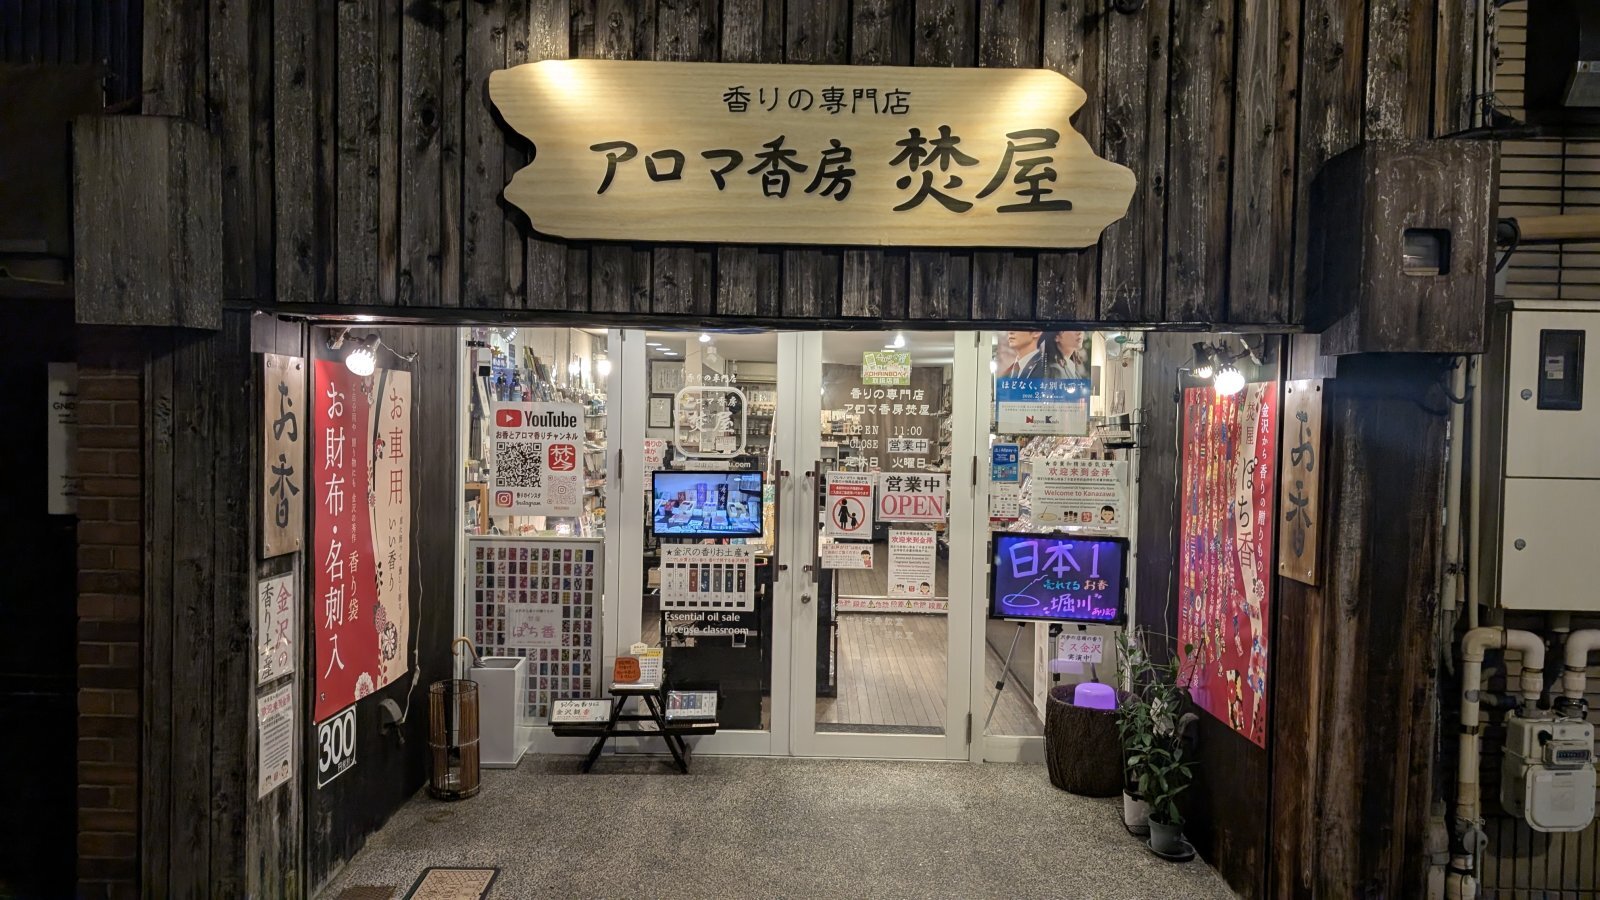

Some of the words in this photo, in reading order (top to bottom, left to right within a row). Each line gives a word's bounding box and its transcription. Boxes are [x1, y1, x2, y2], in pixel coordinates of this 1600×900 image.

[722, 85, 912, 116] 香りの専門店
[589, 134, 857, 202] アロマ香房
[888, 124, 1073, 214] 焚屋
[850, 387, 925, 401] 香りの専門店
[843, 403, 930, 416] アロマ香房焚屋
[524, 411, 577, 428] YouTube
[495, 430, 579, 441] お香とアロマ香りチャンネル
[850, 425, 880, 435] OPEN
[894, 426, 923, 436] 11:00
[388, 387, 404, 506] お車用
[849, 439, 879, 449] CLOSE
[888, 439, 928, 452] 営業中
[269, 381, 300, 529] お香
[845, 457, 879, 468] 定休日
[891, 457, 927, 469] 火曜日
[1048, 467, 1112, 477] 欢迎来到金泽
[885, 475, 941, 493] 営業中
[1256, 402, 1270, 573] 金沢から香りの贈りもの
[1285, 410, 1316, 558] お香
[1083, 490, 1116, 498] Kanazawa
[881, 494, 944, 516] OPEN
[324, 381, 346, 679] お財布・名刺入
[388, 517, 397, 592] いい香り
[674, 547, 743, 557] 金沢の香りお土産
[1009, 540, 1100, 579] 日本1
[348, 550, 359, 622] 香り袋
[276, 581, 292, 668] 金沢の
[664, 611, 705, 621] Essential
[707, 612, 719, 621] oil
[721, 613, 741, 622] sale
[260, 582, 275, 680] 香り土産
[703, 625, 749, 635] classroom
[320, 711, 355, 773] 300
